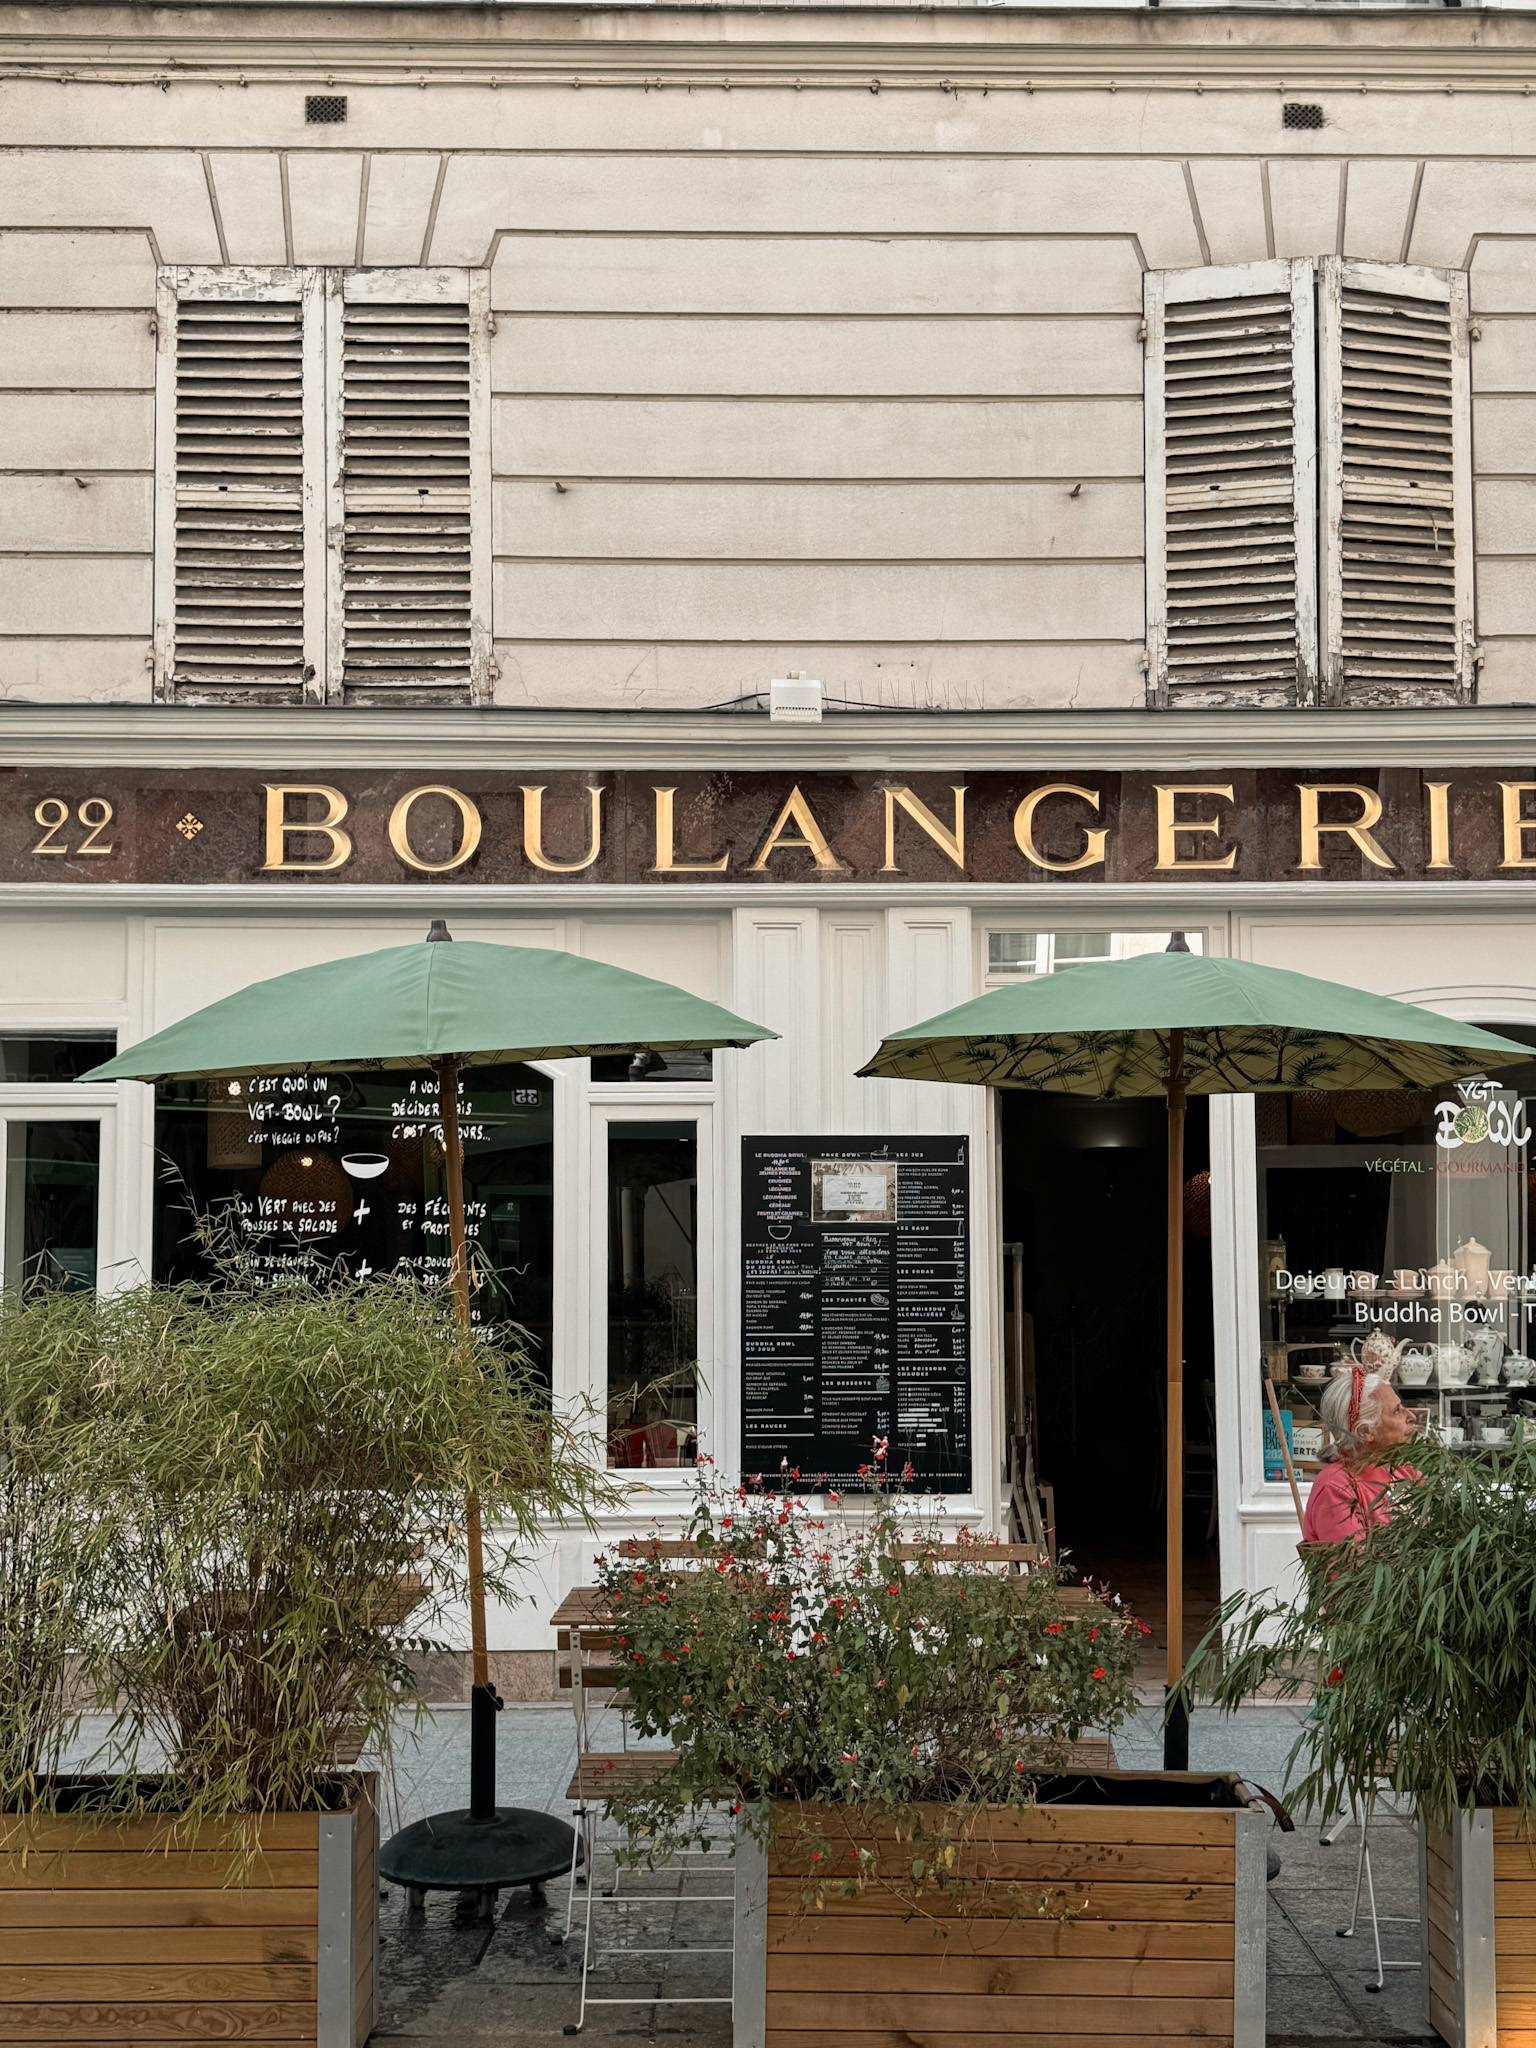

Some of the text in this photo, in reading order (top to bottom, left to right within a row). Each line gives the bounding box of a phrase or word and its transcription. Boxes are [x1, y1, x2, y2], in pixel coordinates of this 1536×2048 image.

[32, 798, 115, 857] 22
[313, 1077, 328, 1092] UN
[421, 1081, 440, 1094] VOU
[1457, 1081, 1503, 1101] VGT
[1365, 1158, 1425, 1173] VÉGÉTAL
[1437, 1161, 1526, 1175] GOURMAND
[241, 1196, 336, 1216] DU VERT AVEC DES
[398, 1202, 417, 1214] DES
[241, 1218, 338, 1233] POUSSES DE SALADE
[402, 1220, 413, 1231] ET
[1276, 1269, 1379, 1295] Dejeuner
[1400, 1268, 1468, 1291] Lunch
[1355, 1302, 1442, 1323] Buddha
[1450, 1302, 1503, 1323] Bowl
